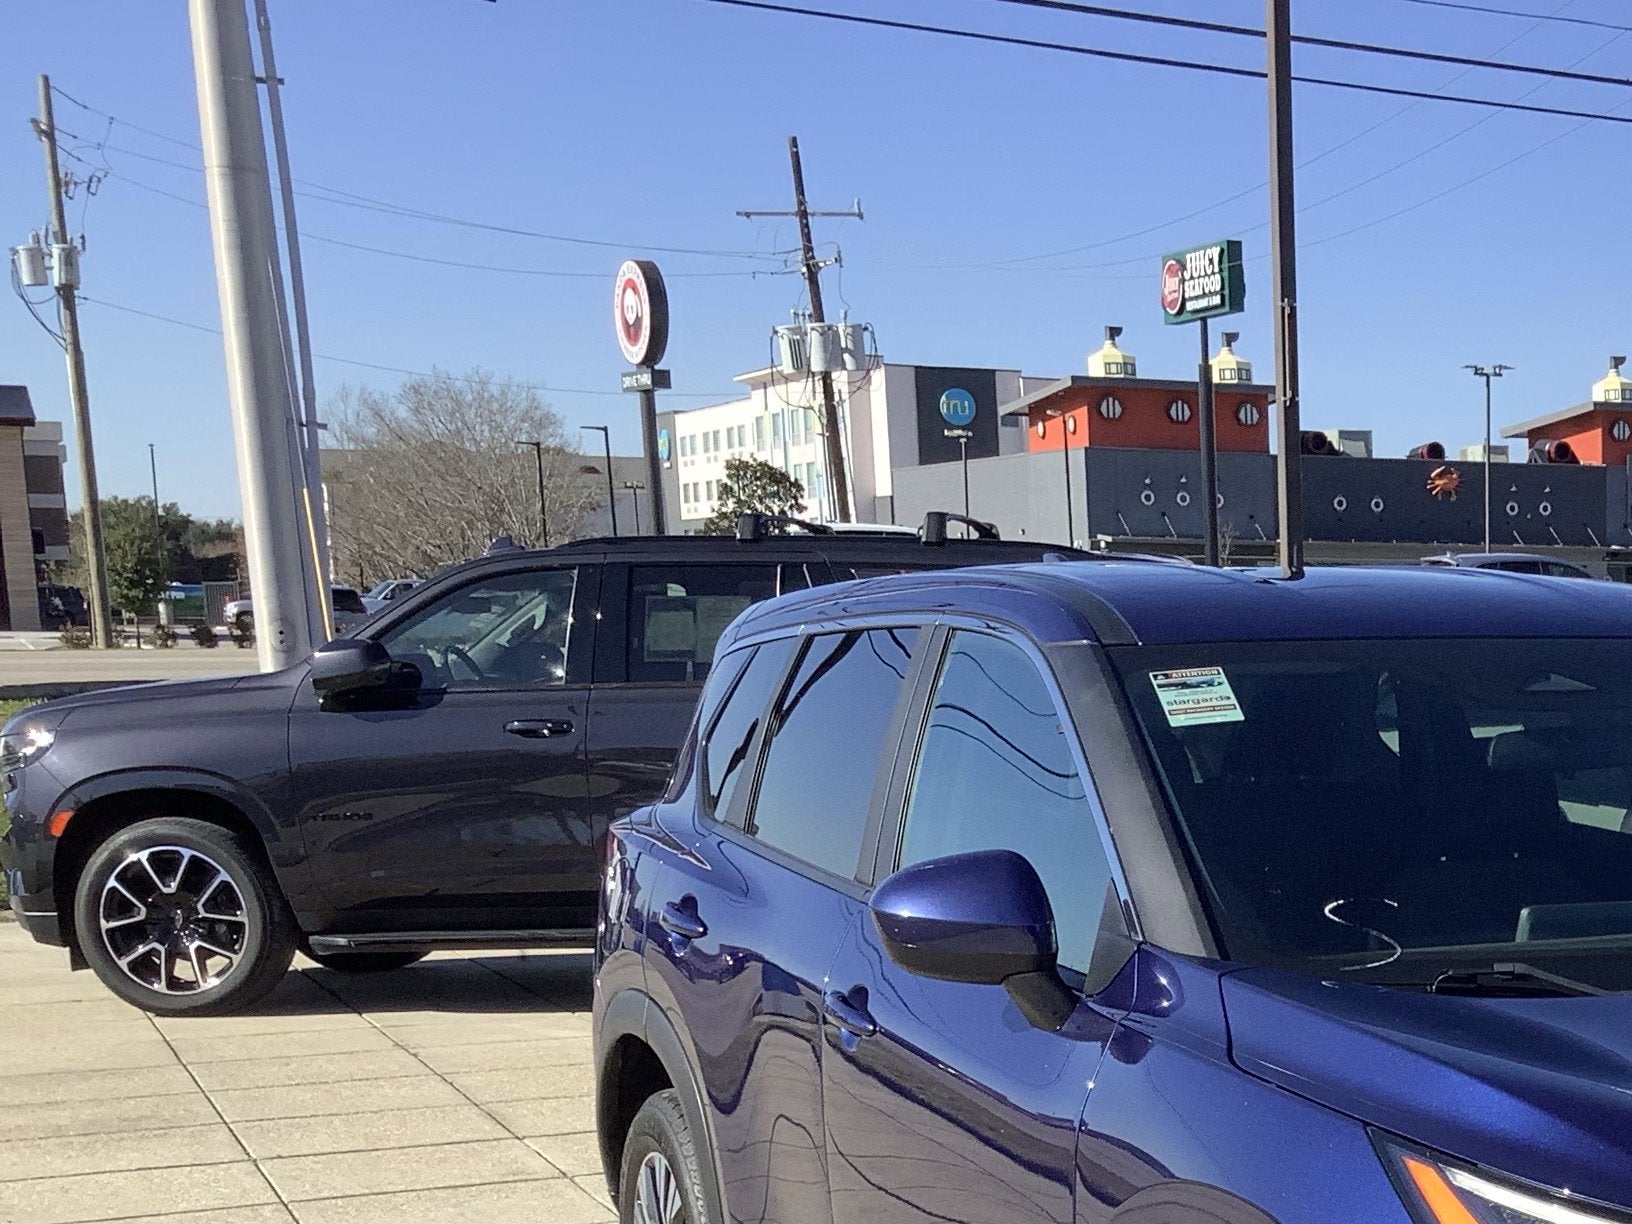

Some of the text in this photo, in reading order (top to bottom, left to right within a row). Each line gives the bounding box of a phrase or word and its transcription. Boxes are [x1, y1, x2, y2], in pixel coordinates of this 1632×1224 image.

[1183, 246, 1221, 280] JUICY
[1183, 273, 1222, 298] SEAFOOD
[1171, 668, 1219, 679] ATTENTION
